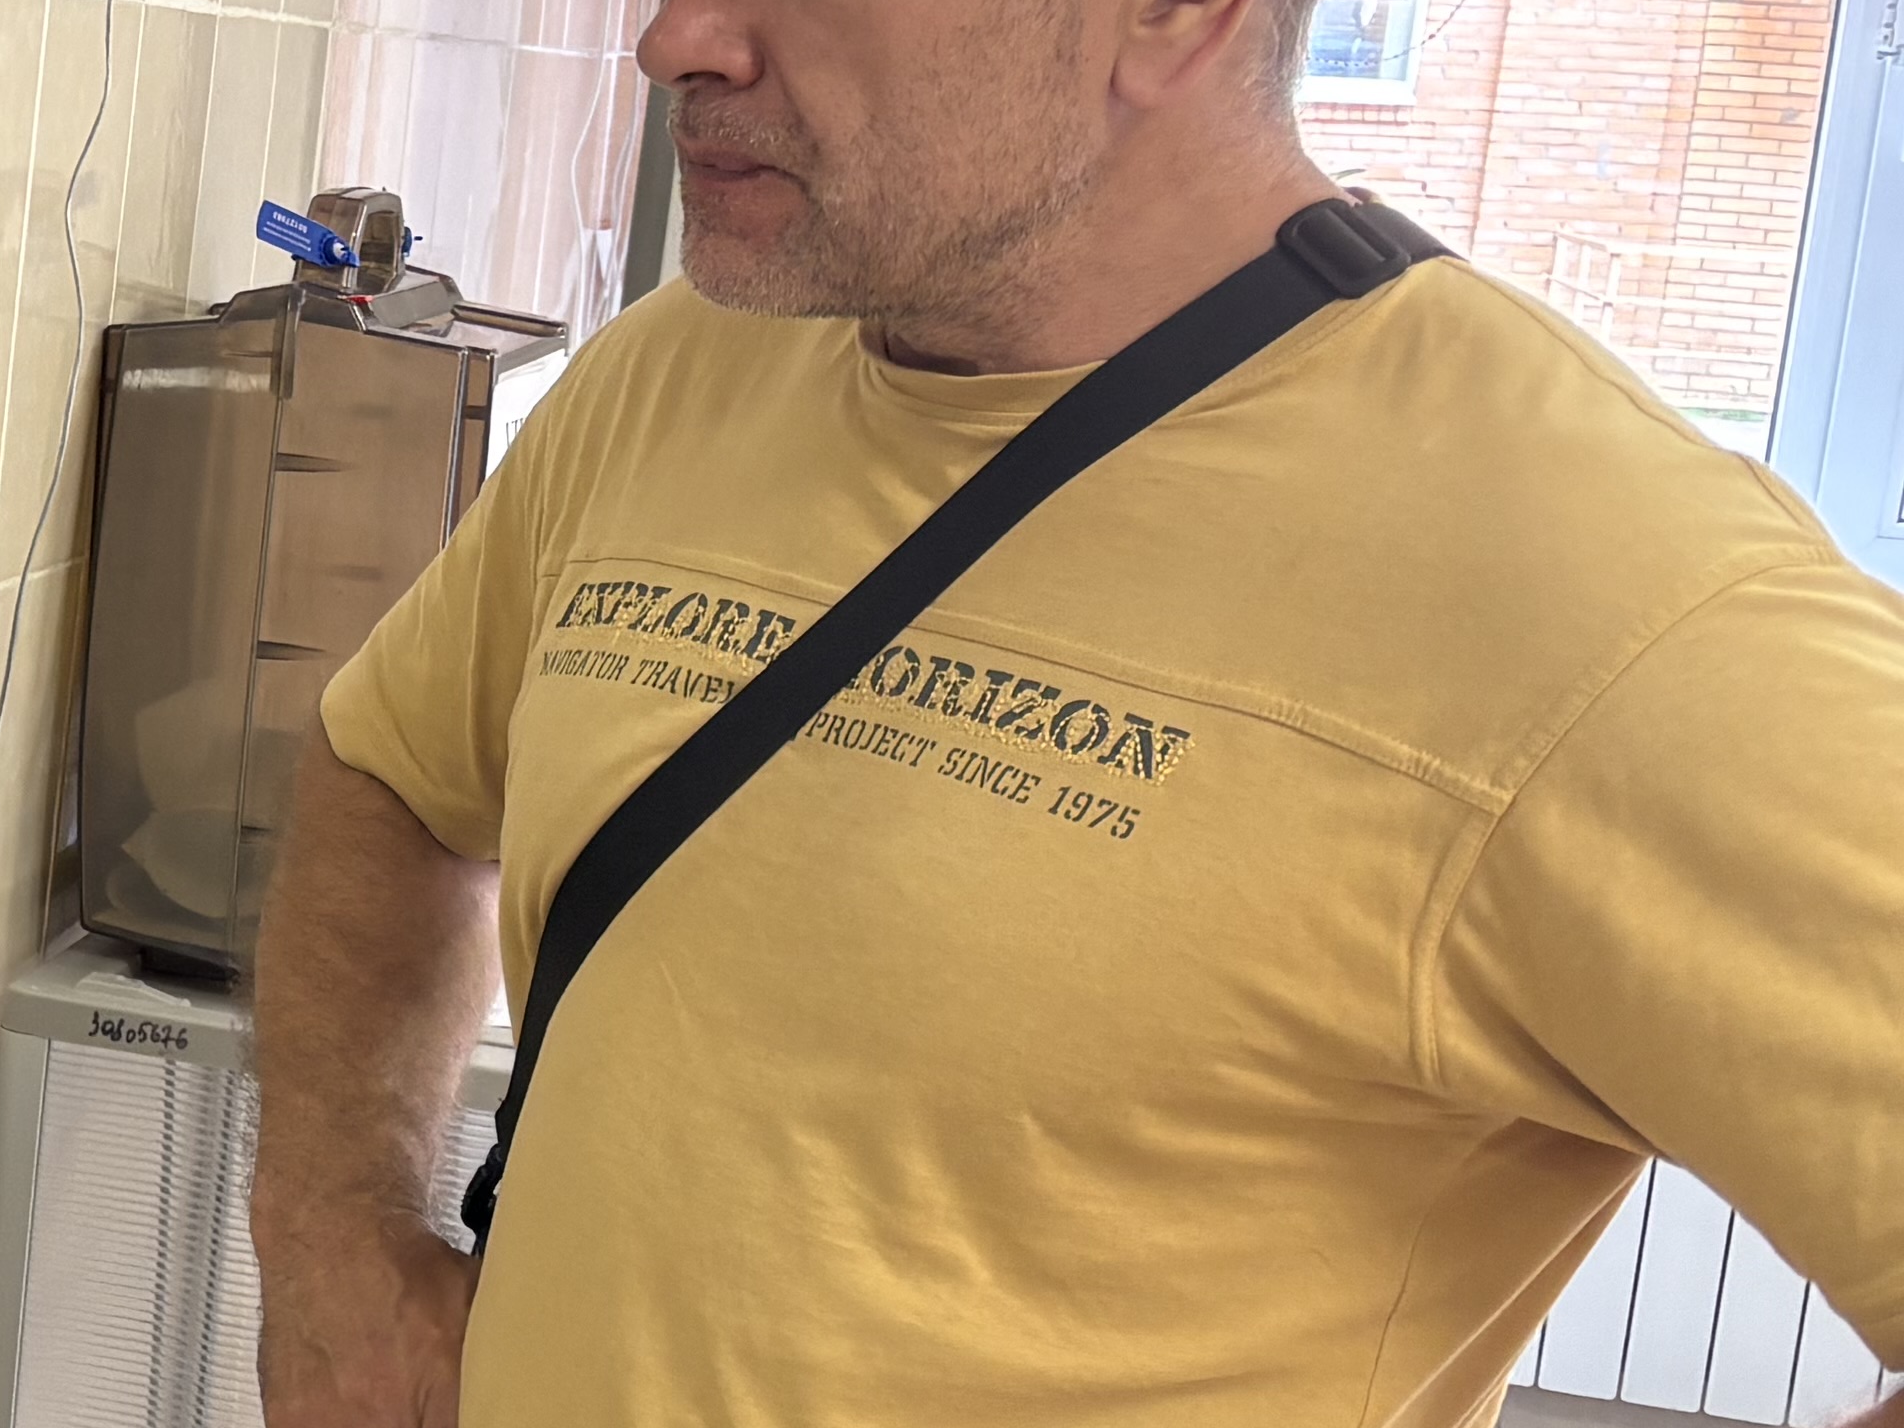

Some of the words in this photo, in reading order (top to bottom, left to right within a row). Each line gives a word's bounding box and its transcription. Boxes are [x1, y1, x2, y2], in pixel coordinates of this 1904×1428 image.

[541, 649, 629, 681] NAVIGATOR
[806, 712, 937, 767] PROJECT
[938, 747, 1042, 804] SINCE
[1048, 785, 1141, 839] 1975
[846, 645, 1191, 780] ORIZON
